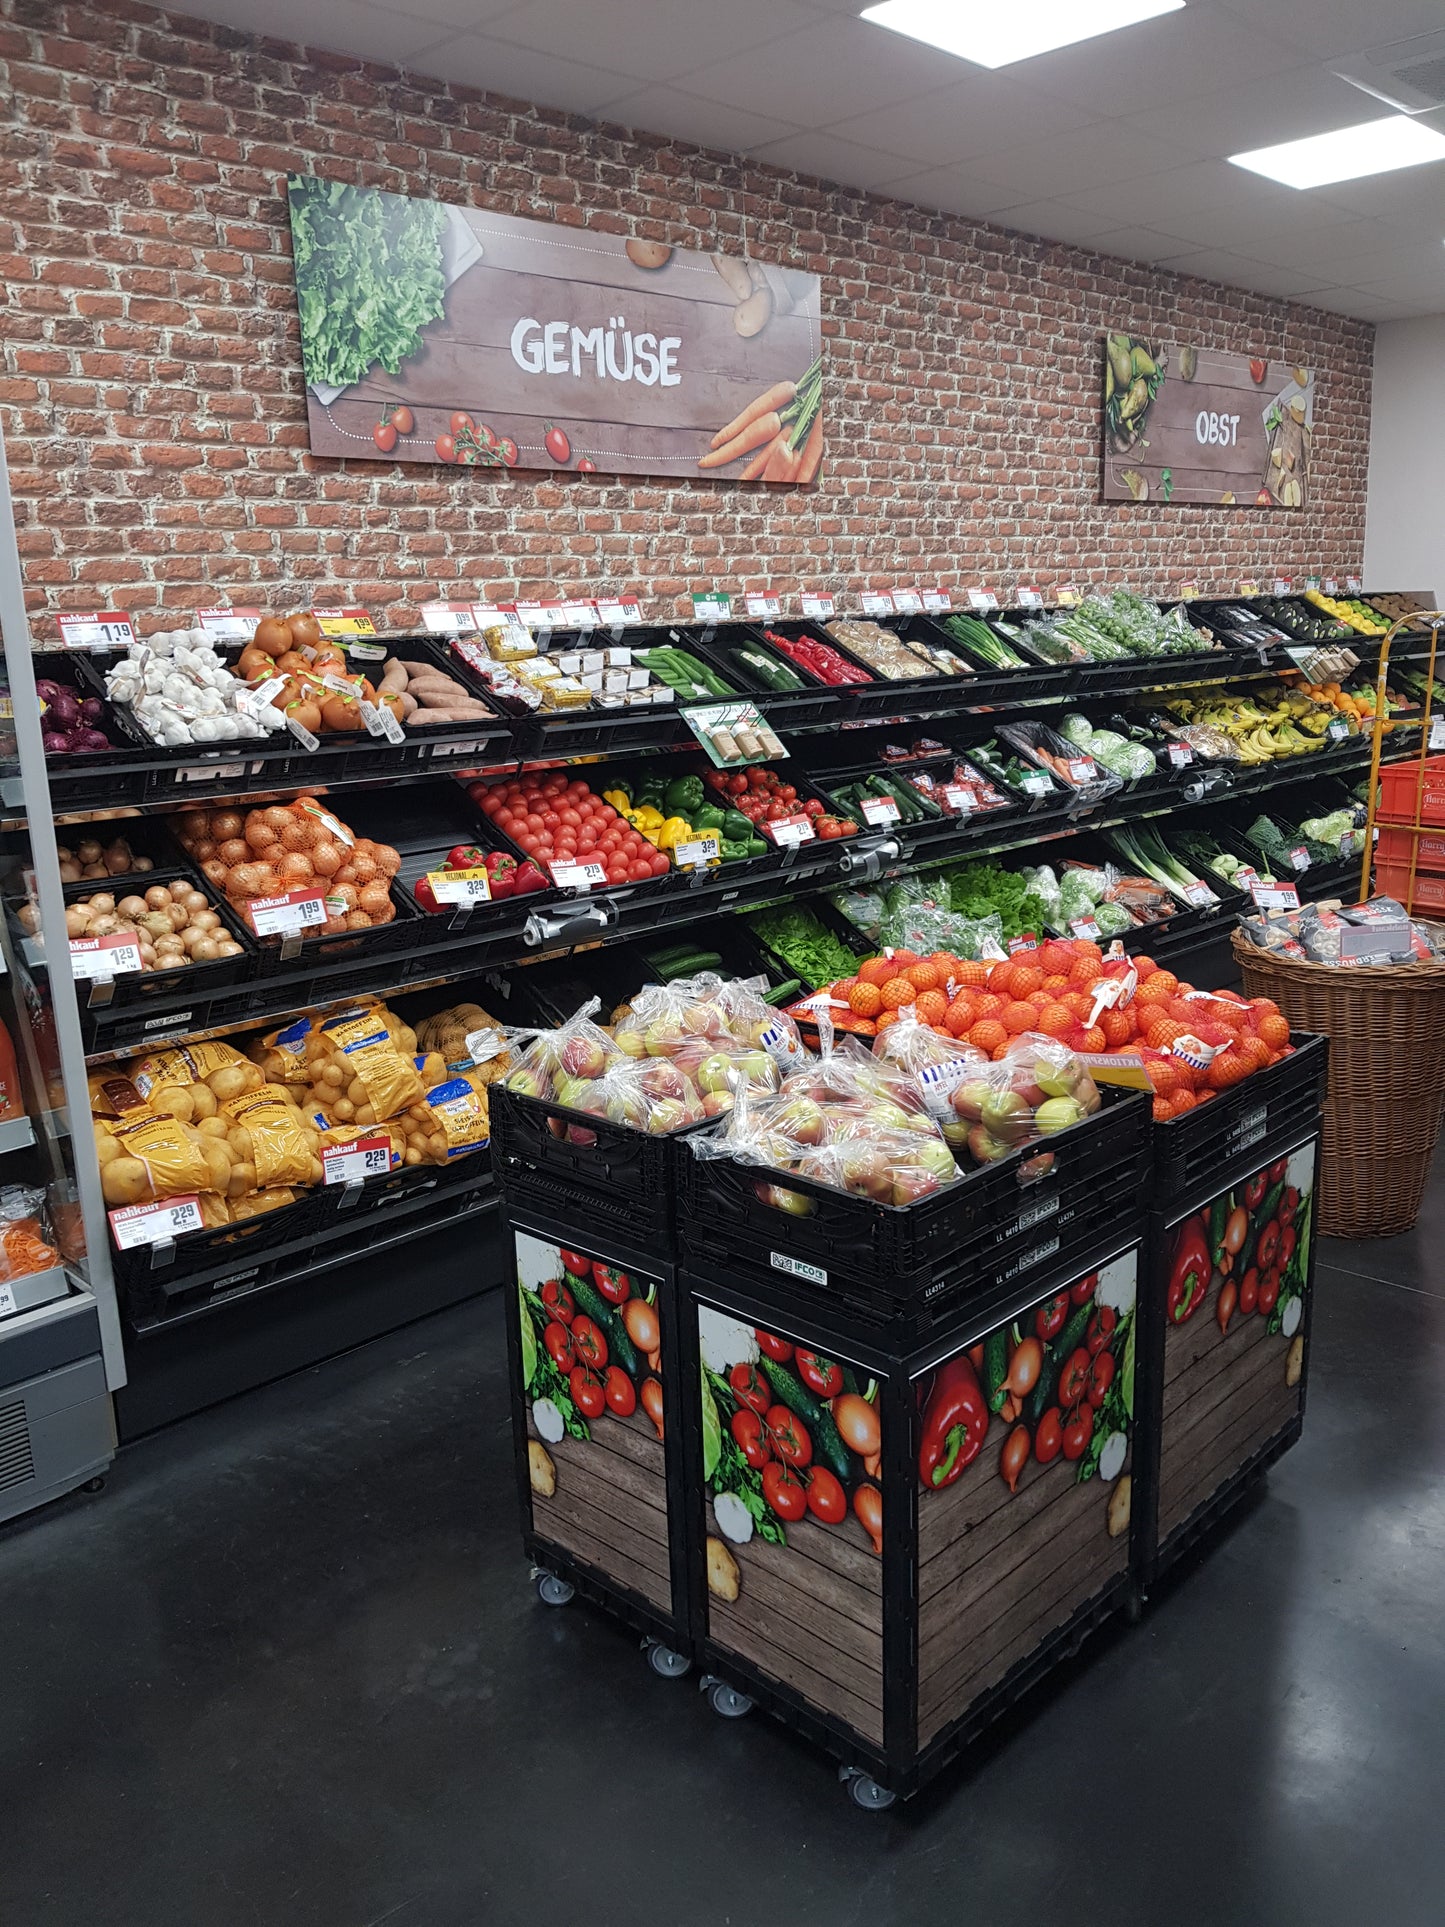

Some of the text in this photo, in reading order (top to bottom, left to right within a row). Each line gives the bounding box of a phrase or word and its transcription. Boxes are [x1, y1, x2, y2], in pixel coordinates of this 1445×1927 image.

[510, 316, 682, 387] GEMÜSE
[1196, 410, 1240, 446] OBST
[100, 624, 131, 642] 1.19
[701, 839, 716, 854] 3.29
[467, 880, 485, 895] 3.29
[251, 894, 290, 910] nahkauf
[298, 901, 320, 919] 1.99
[69, 938, 100, 953] hkauf
[110, 946, 134, 966] 1.29
[323, 1141, 358, 1158] nahkauf
[365, 1150, 386, 1168] 2.29
[113, 1202, 160, 1221] nahkauf
[170, 1204, 195, 1226] 2.29
[794, 1261, 815, 1276] IFCO
[925, 1281, 945, 1298] LL4314
